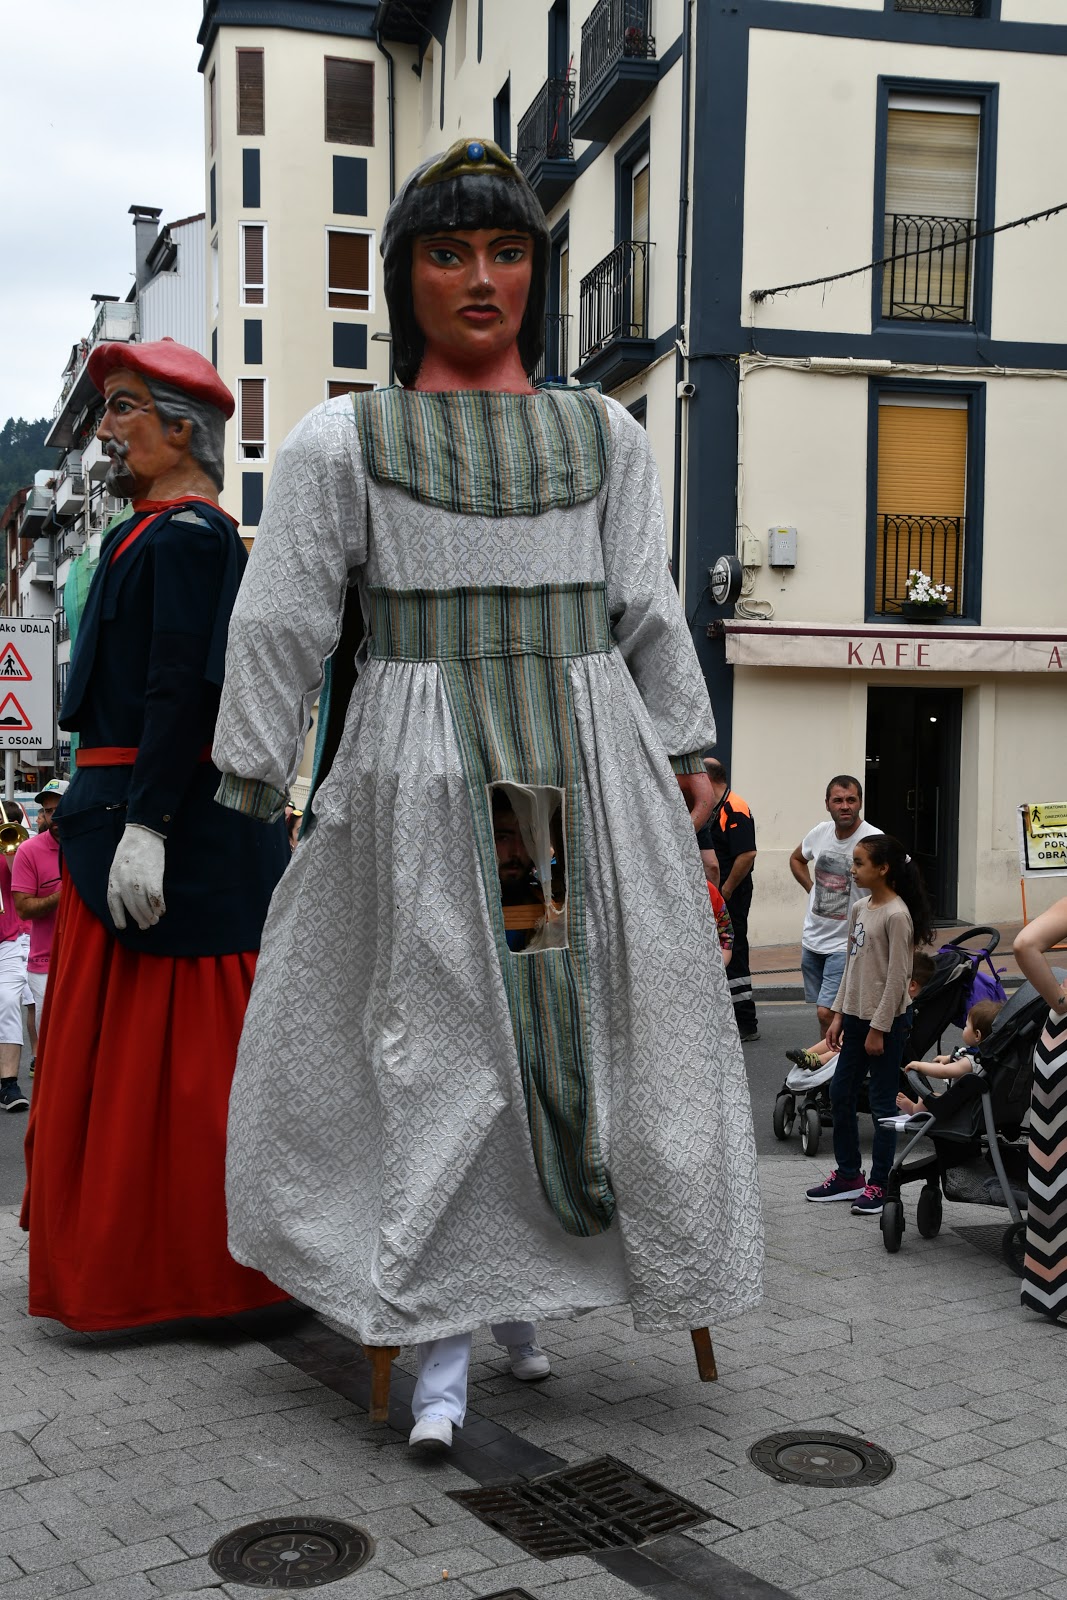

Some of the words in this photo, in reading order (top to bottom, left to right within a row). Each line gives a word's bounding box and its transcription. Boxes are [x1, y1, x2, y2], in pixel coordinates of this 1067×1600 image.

[20, 624, 50, 634] UDALA
[847, 641, 931, 667] KAFE
[1047, 646, 1063, 669] A
[8, 736, 42, 745] OSOAN
